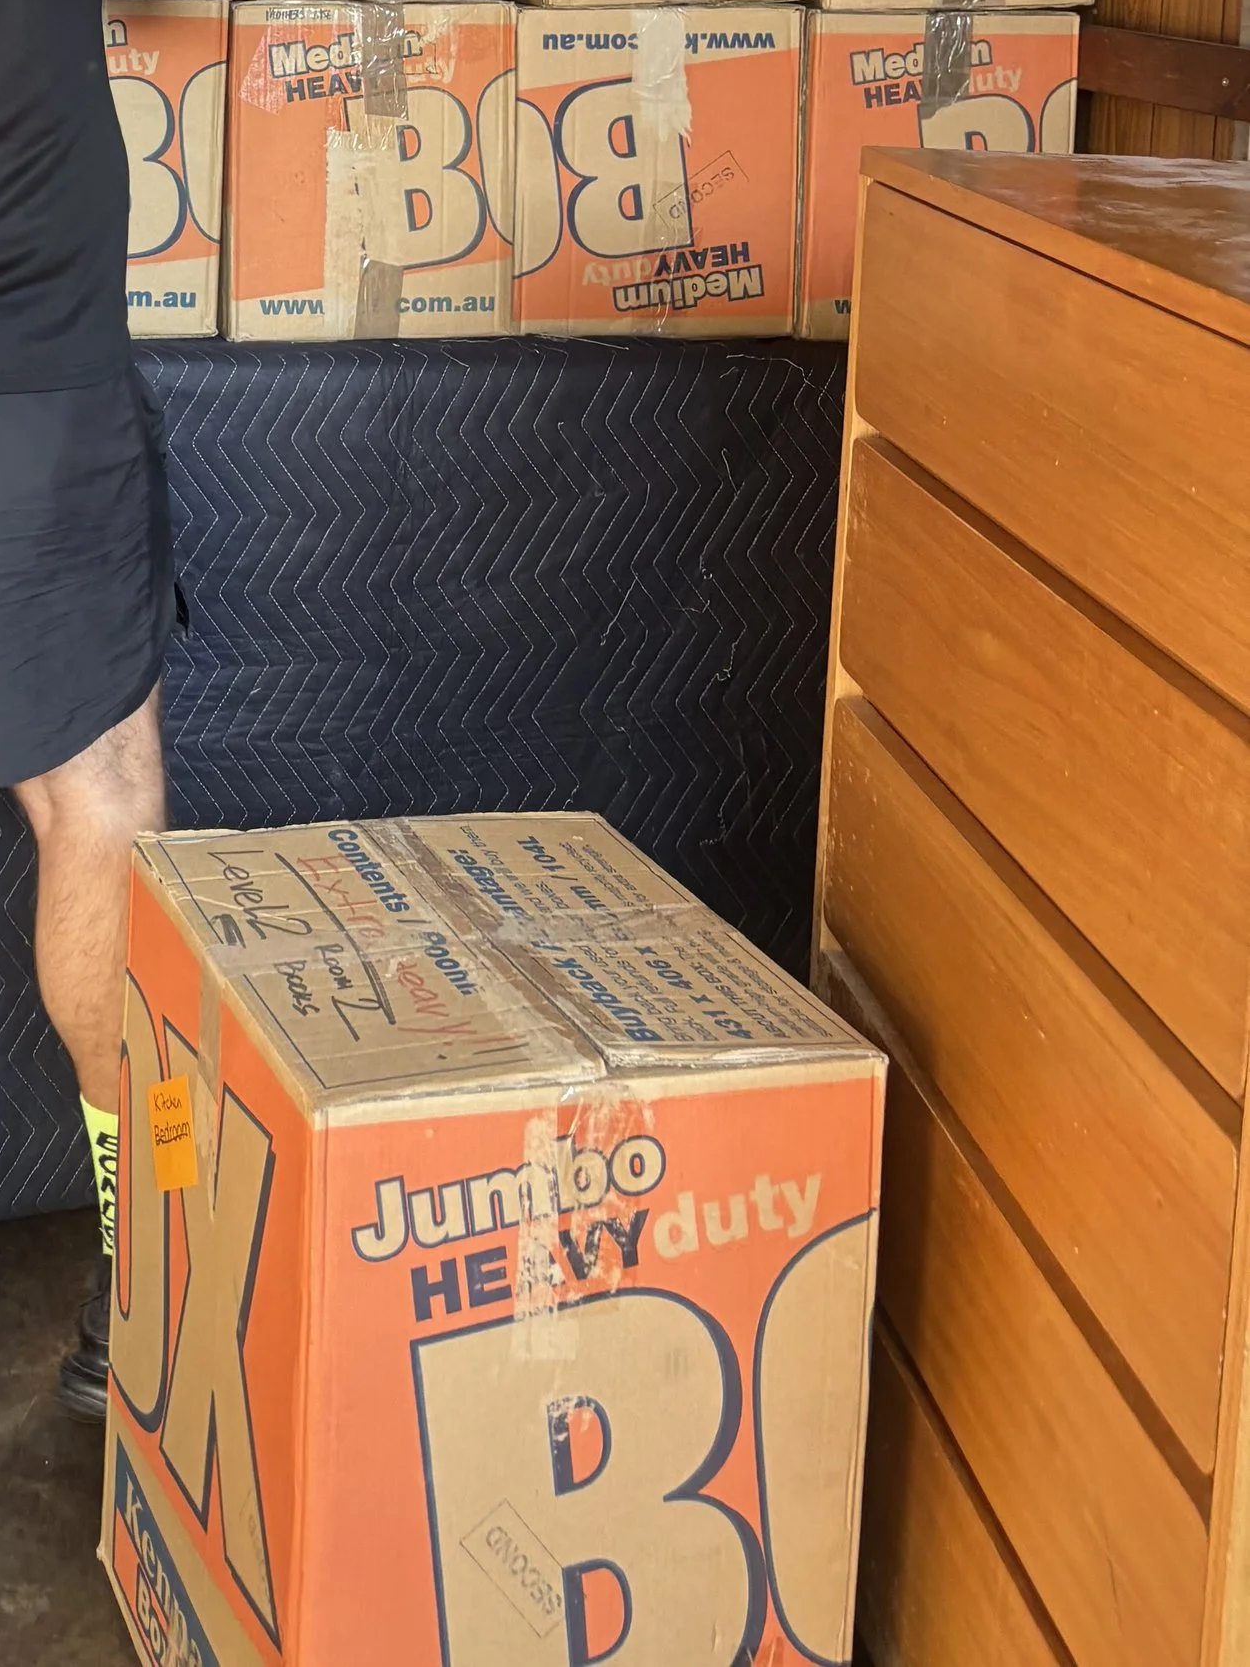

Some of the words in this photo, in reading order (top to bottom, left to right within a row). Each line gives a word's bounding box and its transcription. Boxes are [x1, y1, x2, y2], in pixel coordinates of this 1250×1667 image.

[653, 241, 751, 277] HEAVY
[612, 264, 766, 313] Medium
[327, 828, 412, 914] Contents
[516, 835, 566, 873] 104L
[313, 942, 355, 992] Room
[645, 959, 695, 990] 406
[549, 956, 665, 1042] Buyback
[701, 1009, 756, 1040] 431
[352, 1133, 666, 1263] Jumbo
[409, 1209, 650, 1323] HEAVY
[653, 1172, 823, 1260] duty
